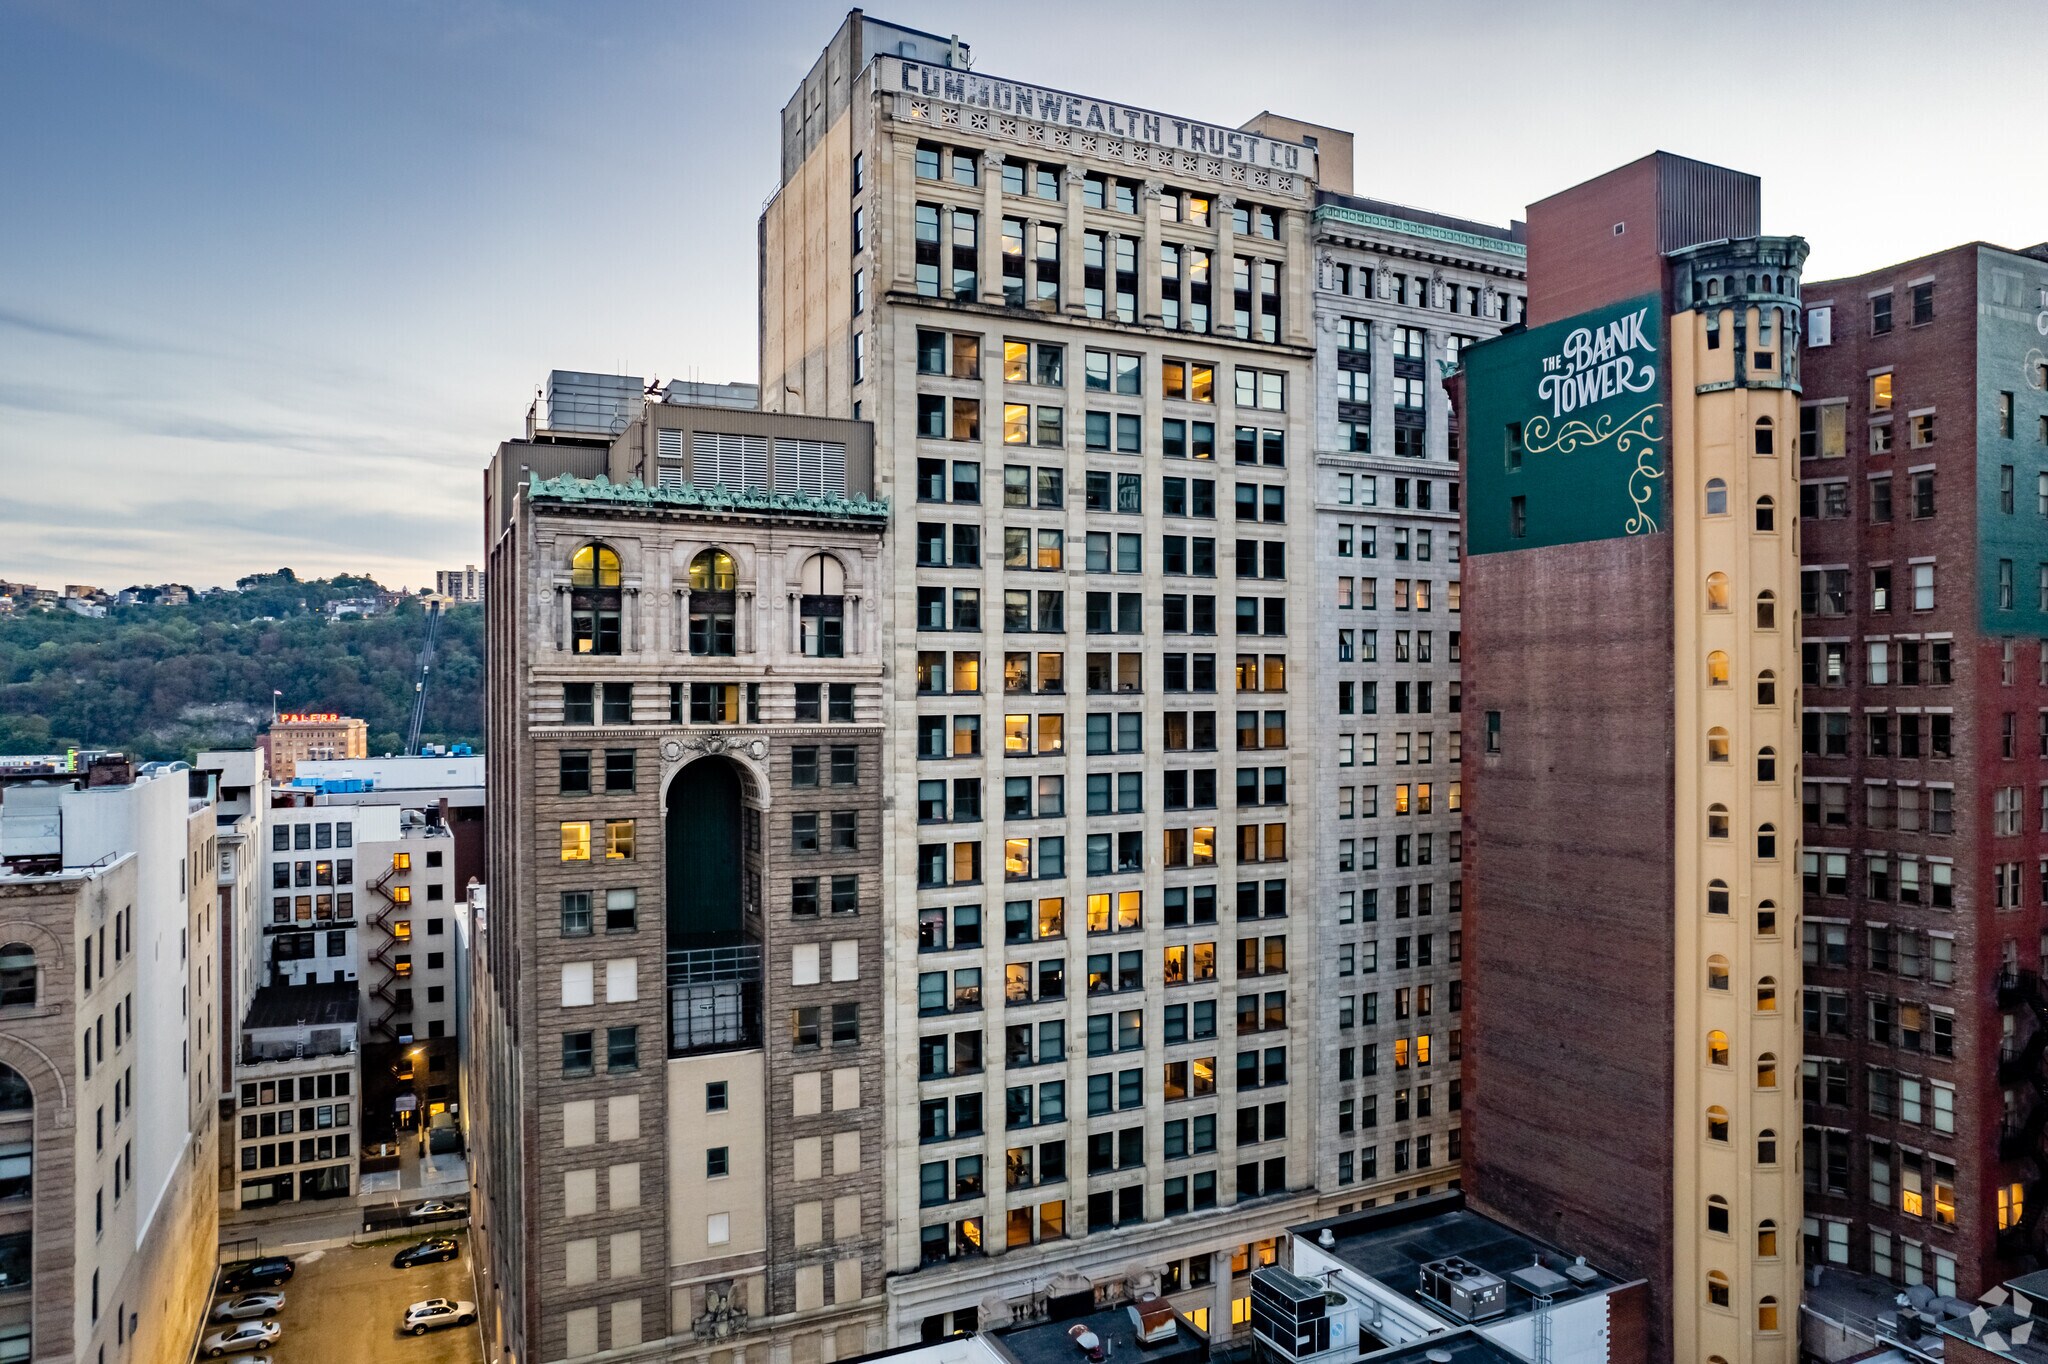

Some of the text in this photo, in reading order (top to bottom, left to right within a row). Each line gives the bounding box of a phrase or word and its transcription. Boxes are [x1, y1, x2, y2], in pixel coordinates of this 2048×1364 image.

[901, 61, 1299, 170] COMMONWEALTH TRUST CO
[1542, 307, 1657, 373] THE BANK
[1538, 355, 1656, 418] TOWER
